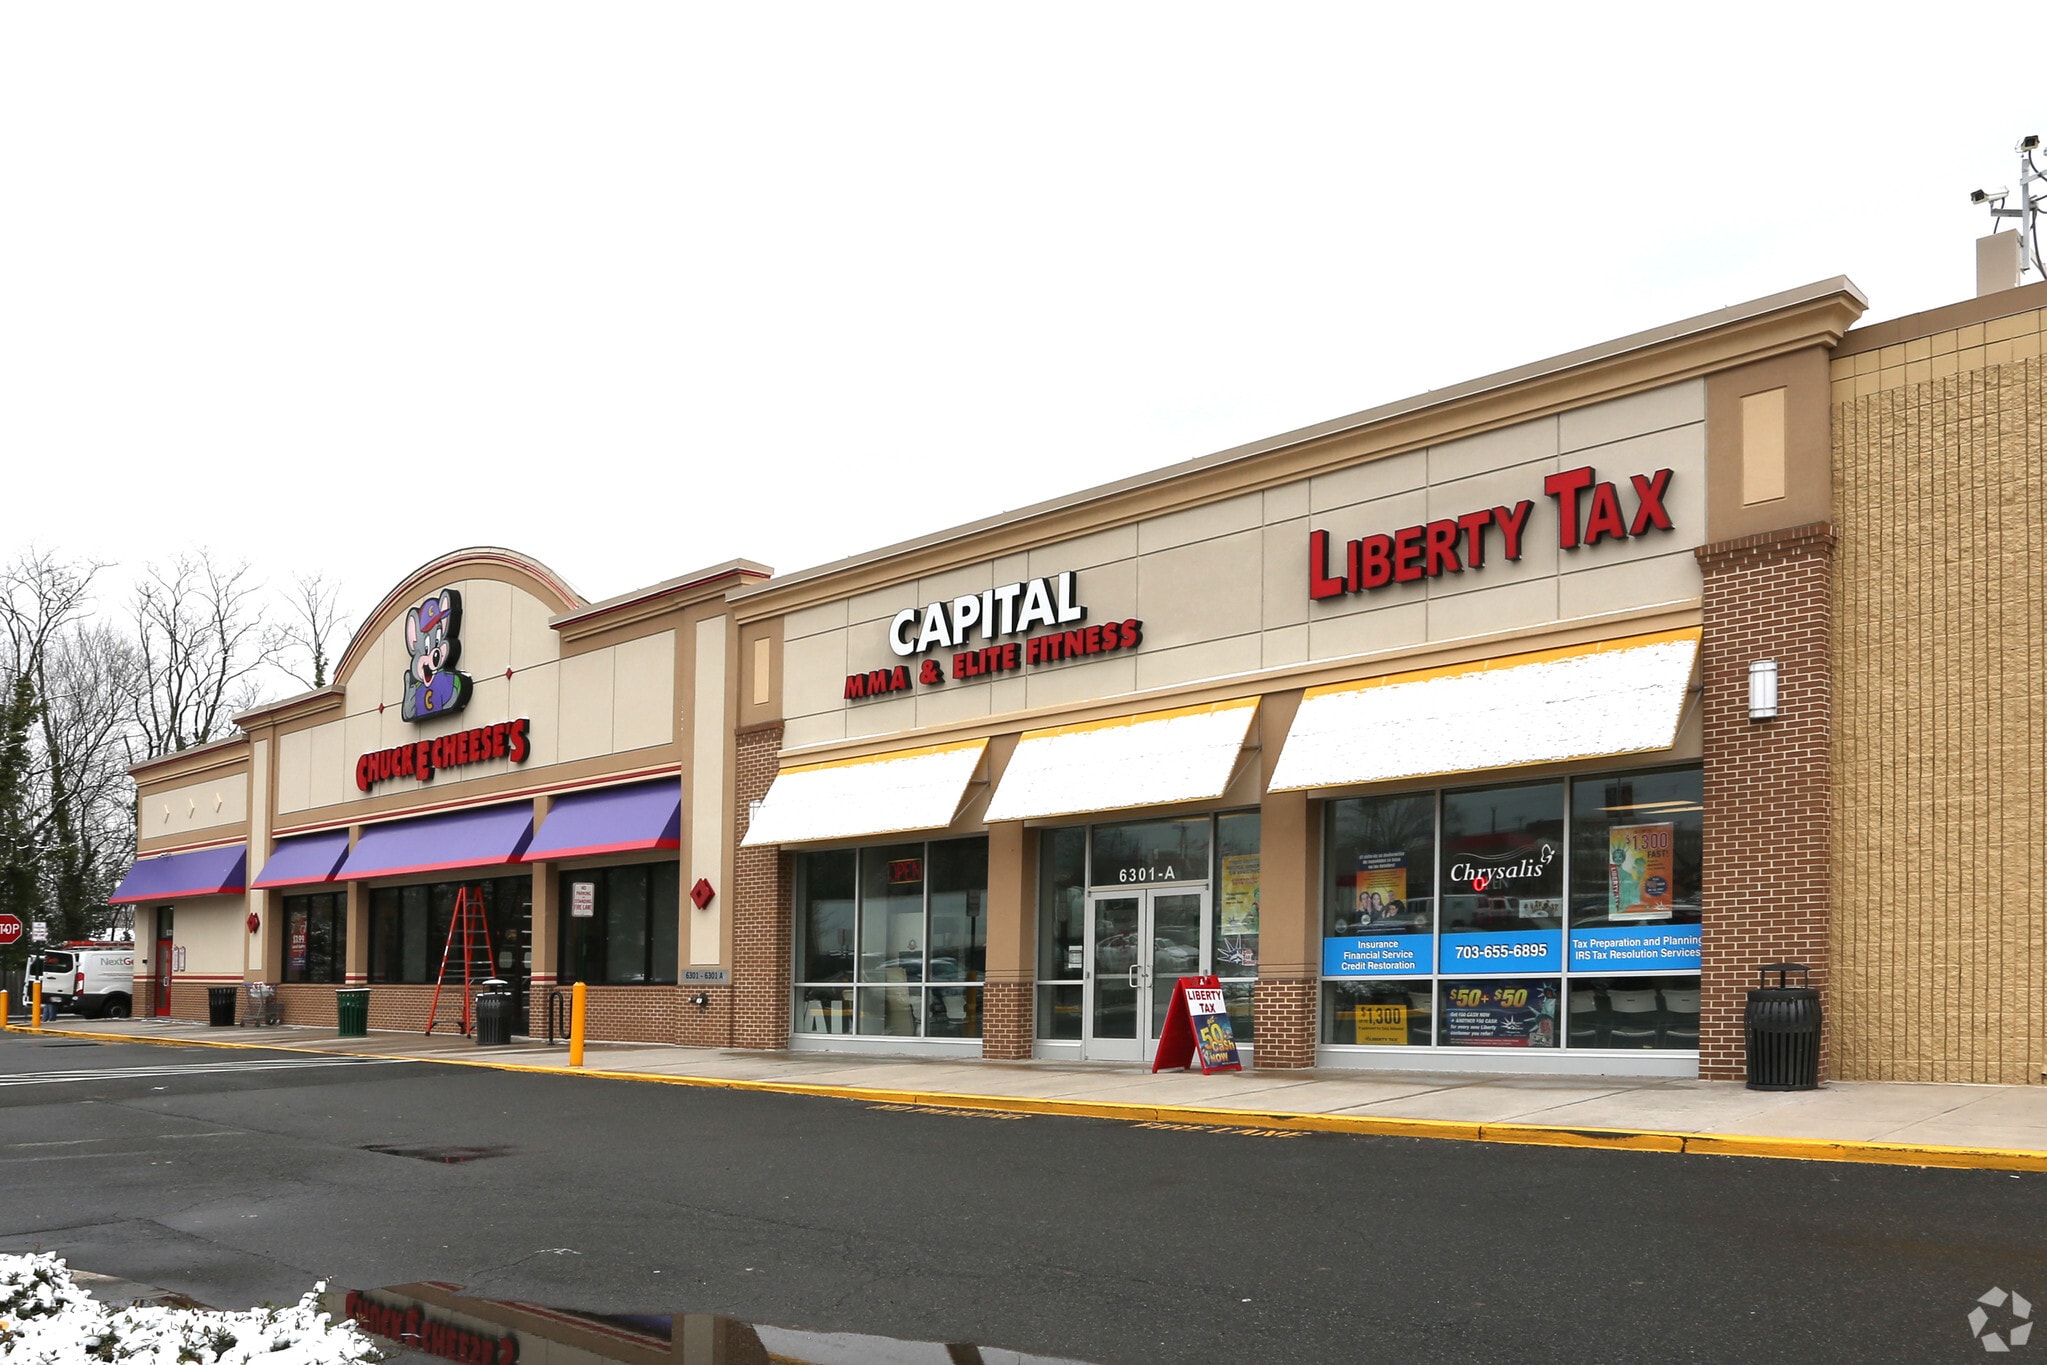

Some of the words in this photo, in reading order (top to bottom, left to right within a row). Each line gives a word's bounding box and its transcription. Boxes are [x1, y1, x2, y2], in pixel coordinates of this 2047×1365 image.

[1309, 500, 1535, 601] LIBERTY
[1544, 466, 1675, 549] TAX
[888, 570, 1086, 657] CAPITAL
[844, 665, 912, 699] MMA
[919, 658, 944, 685] &
[952, 643, 1021, 679] ELITE
[1026, 618, 1143, 665] FITNESS
[356, 741, 414, 792] CHUCK
[415, 740, 435, 782] E
[431, 718, 530, 769] CHEESE'S
[888, 860, 923, 884] OPEN
[1119, 865, 1176, 883] 6301-A
[1450, 859, 1544, 887] Chrysalis
[0, 923, 20, 935] TOP
[1358, 940, 1399, 949] Insurance
[1573, 939, 1588, 949] Tax
[1590, 937, 1641, 949] Preparation
[1643, 936, 1660, 947] and
[1343, 950, 1380, 960] Financial
[1382, 949, 1414, 959] Service
[1455, 943, 1548, 960] 703-655-6895
[1575, 950, 1591, 960] IRS
[1592, 950, 1607, 960] Tax
[1609, 949, 1658, 959] Resolution
[1660, 947, 1701, 958] Services
[1341, 961, 1366, 970] Credit
[1367, 960, 1415, 970] Restoration
[685, 971, 699, 980] 6301
[704, 971, 718, 980] 6301
[719, 971, 724, 980] A
[1187, 990, 1221, 1001] LIBERTY
[1449, 988, 1482, 1008] $50
[1493, 988, 1528, 1008] $50
[1199, 1003, 1216, 1013] TAX
[1360, 1006, 1401, 1025] $1,300
[1210, 1052, 1228, 1063] NOW
